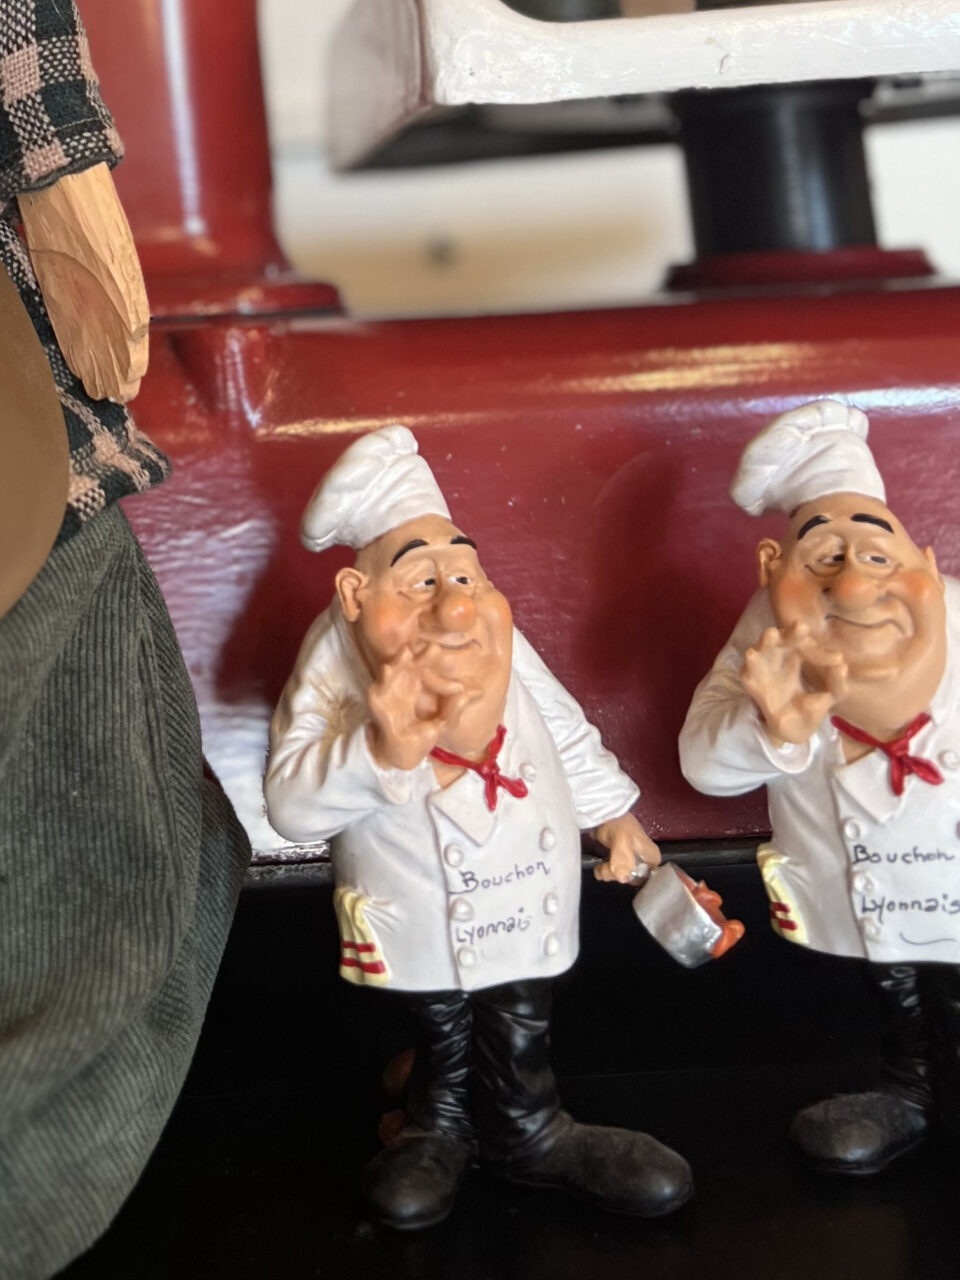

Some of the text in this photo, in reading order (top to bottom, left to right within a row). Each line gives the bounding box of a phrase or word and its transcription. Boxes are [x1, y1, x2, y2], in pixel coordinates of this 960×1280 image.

[852, 844, 955, 866] Bouchon
[451, 861, 550, 894] Bouchon
[862, 893, 960, 925] Lyonnais
